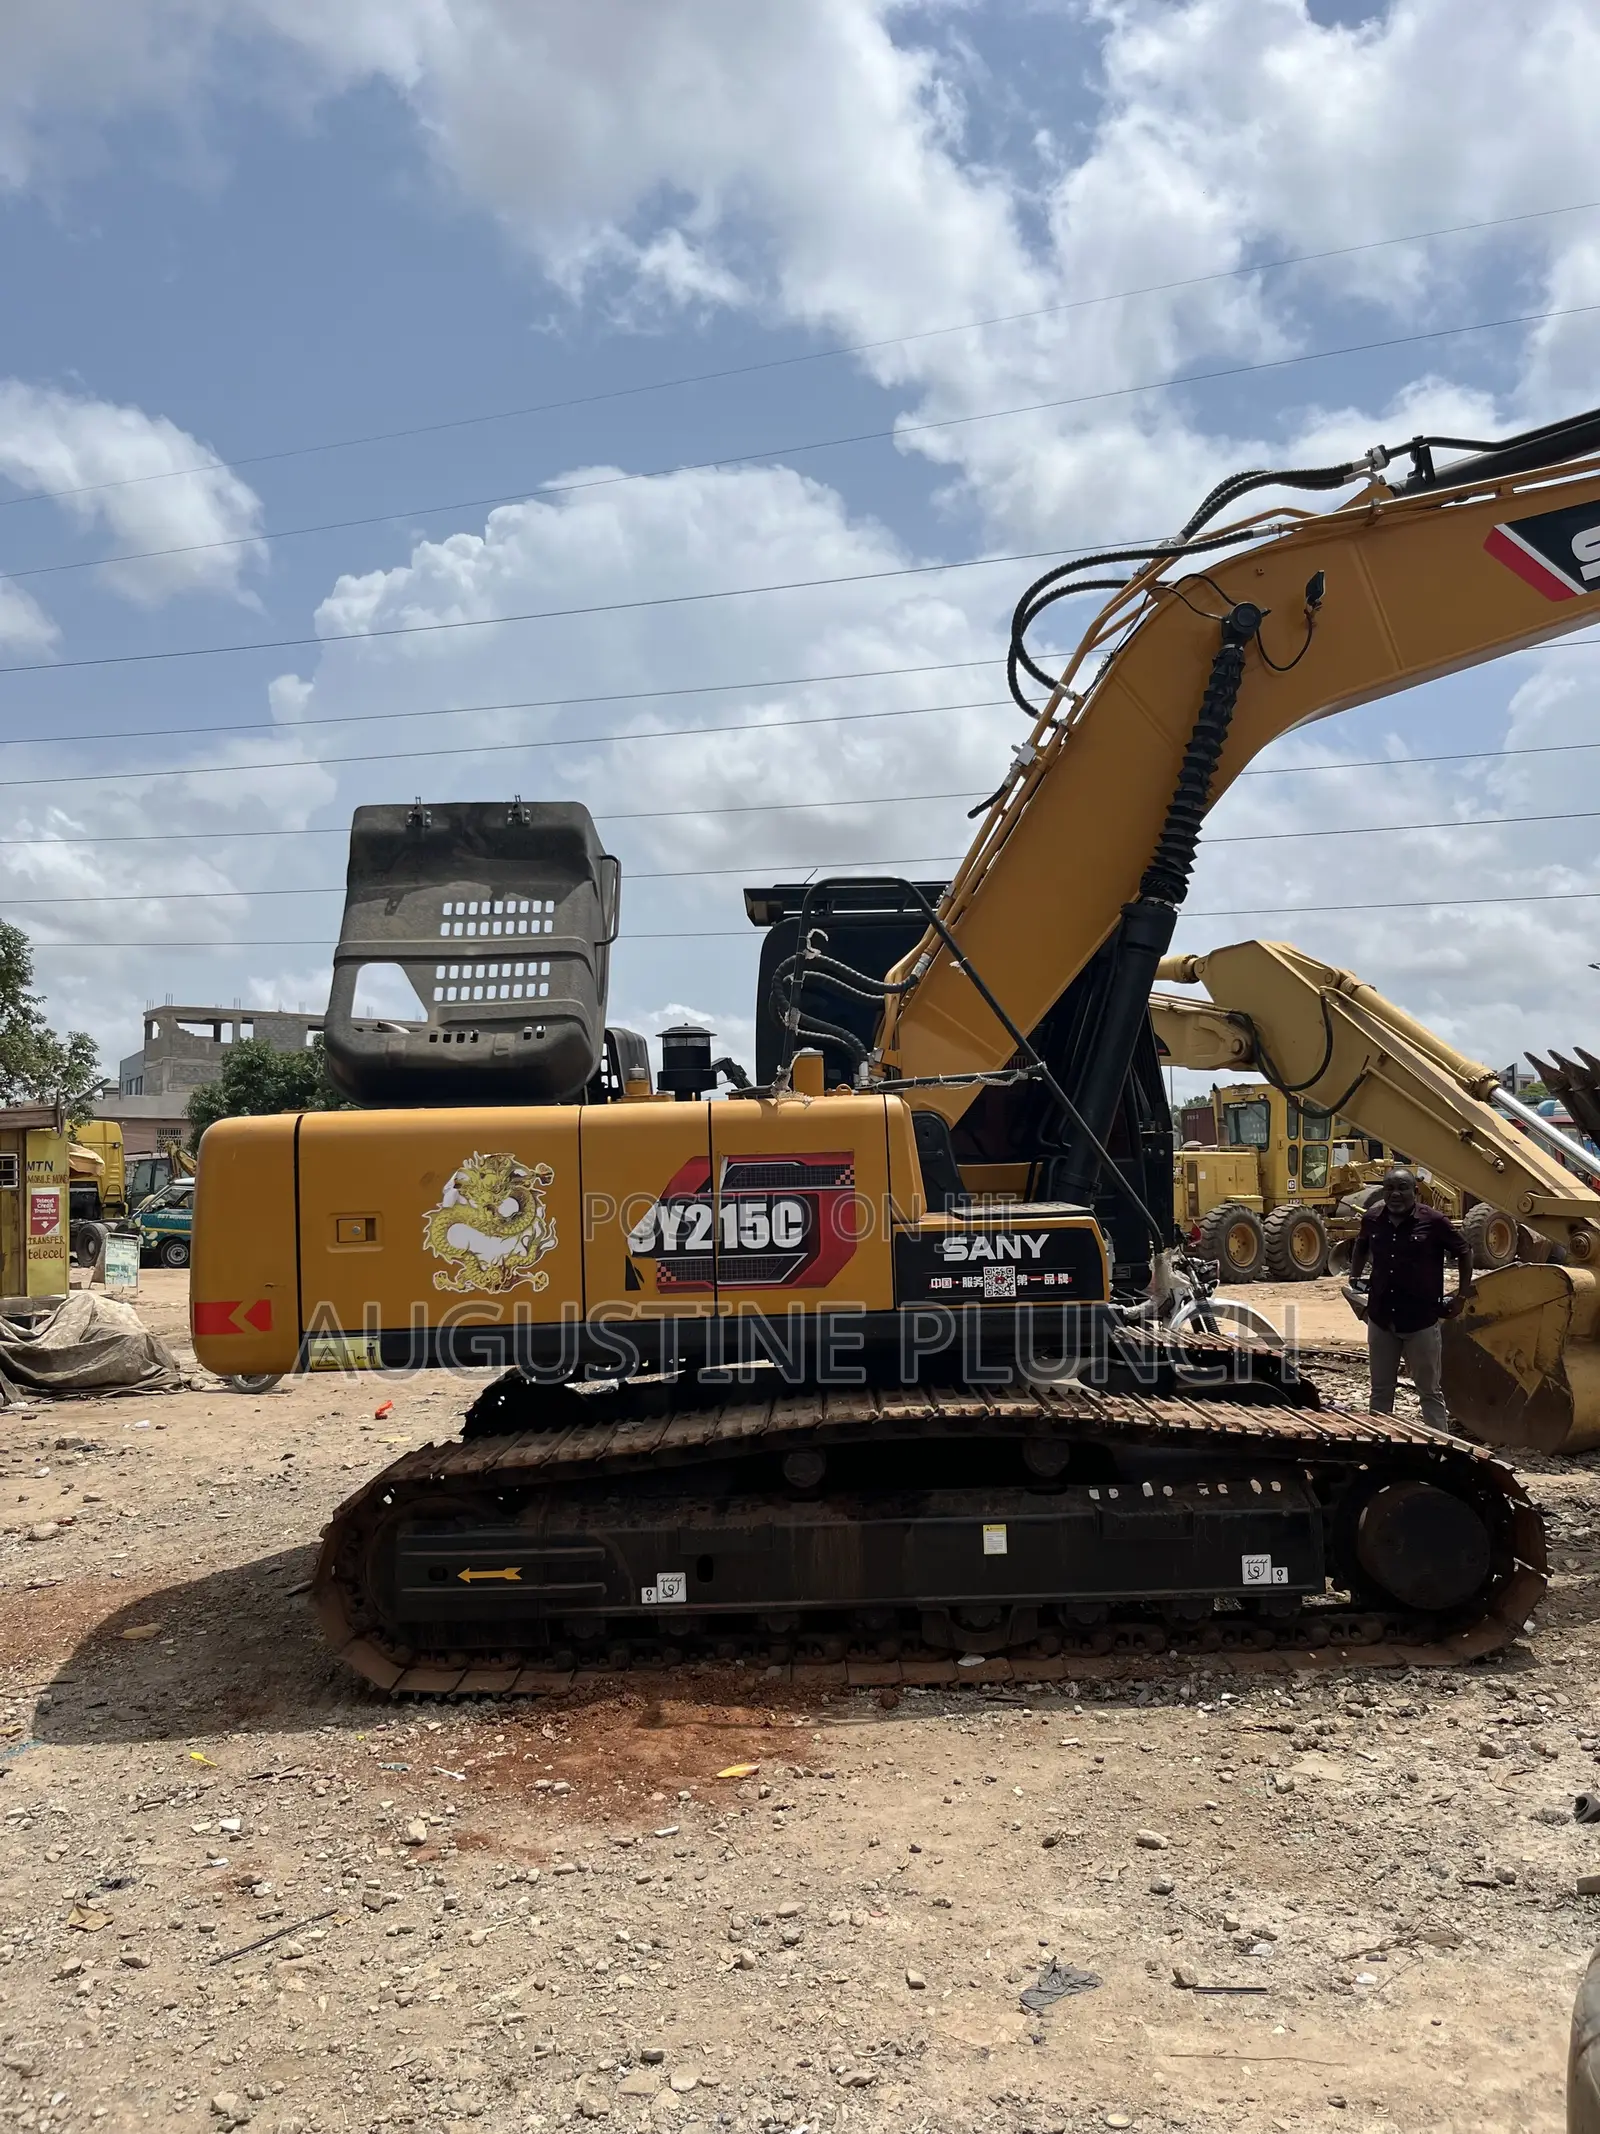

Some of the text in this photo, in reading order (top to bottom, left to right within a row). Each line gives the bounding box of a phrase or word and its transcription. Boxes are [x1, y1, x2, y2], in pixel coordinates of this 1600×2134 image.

[27, 1161, 54, 1171] MTN
[27, 1174, 51, 1184] MOBILE
[28, 1236, 65, 1245] TRANSFER
[942, 1233, 1050, 1262] SANY
[28, 1247, 65, 1260] telecel
